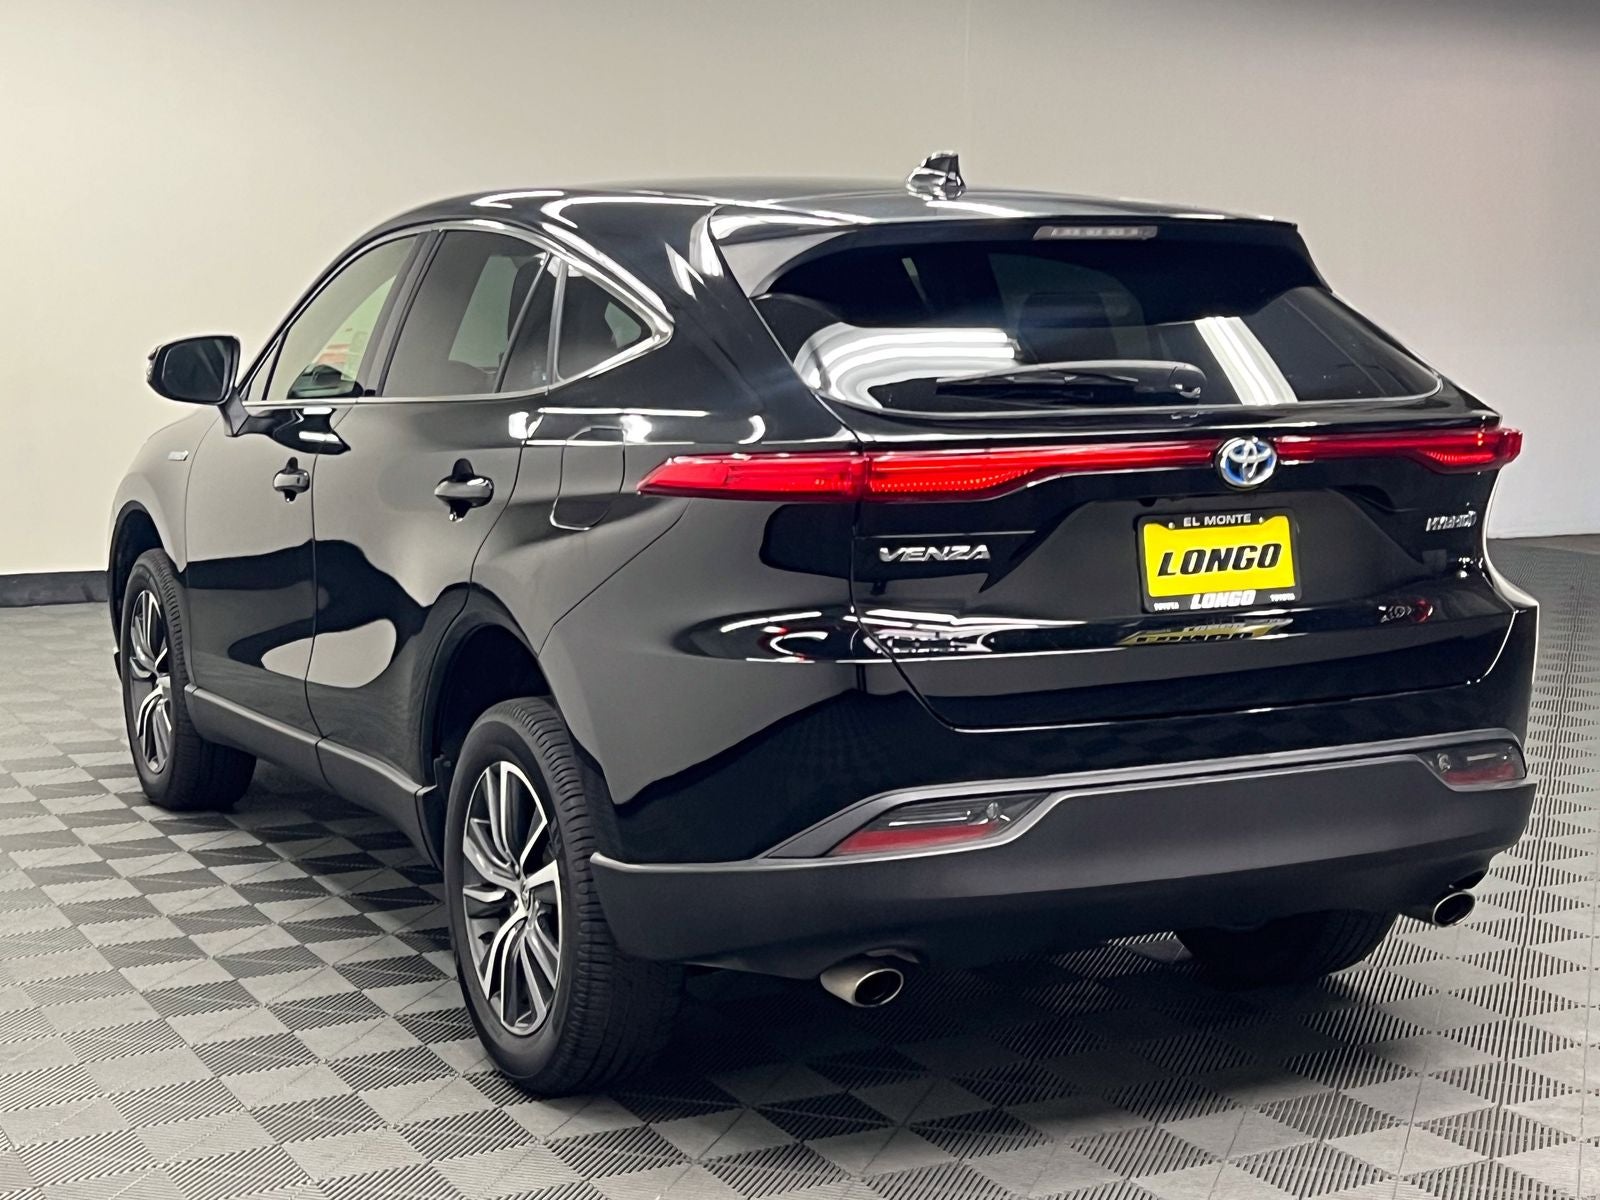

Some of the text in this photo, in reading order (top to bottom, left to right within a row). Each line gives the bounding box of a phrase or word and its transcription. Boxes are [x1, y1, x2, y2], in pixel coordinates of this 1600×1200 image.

[1183, 513, 1252, 527] EL MONTE
[879, 544, 991, 562] VENZA
[1157, 543, 1282, 577] LONGO
[1190, 589, 1256, 610] LONGO
